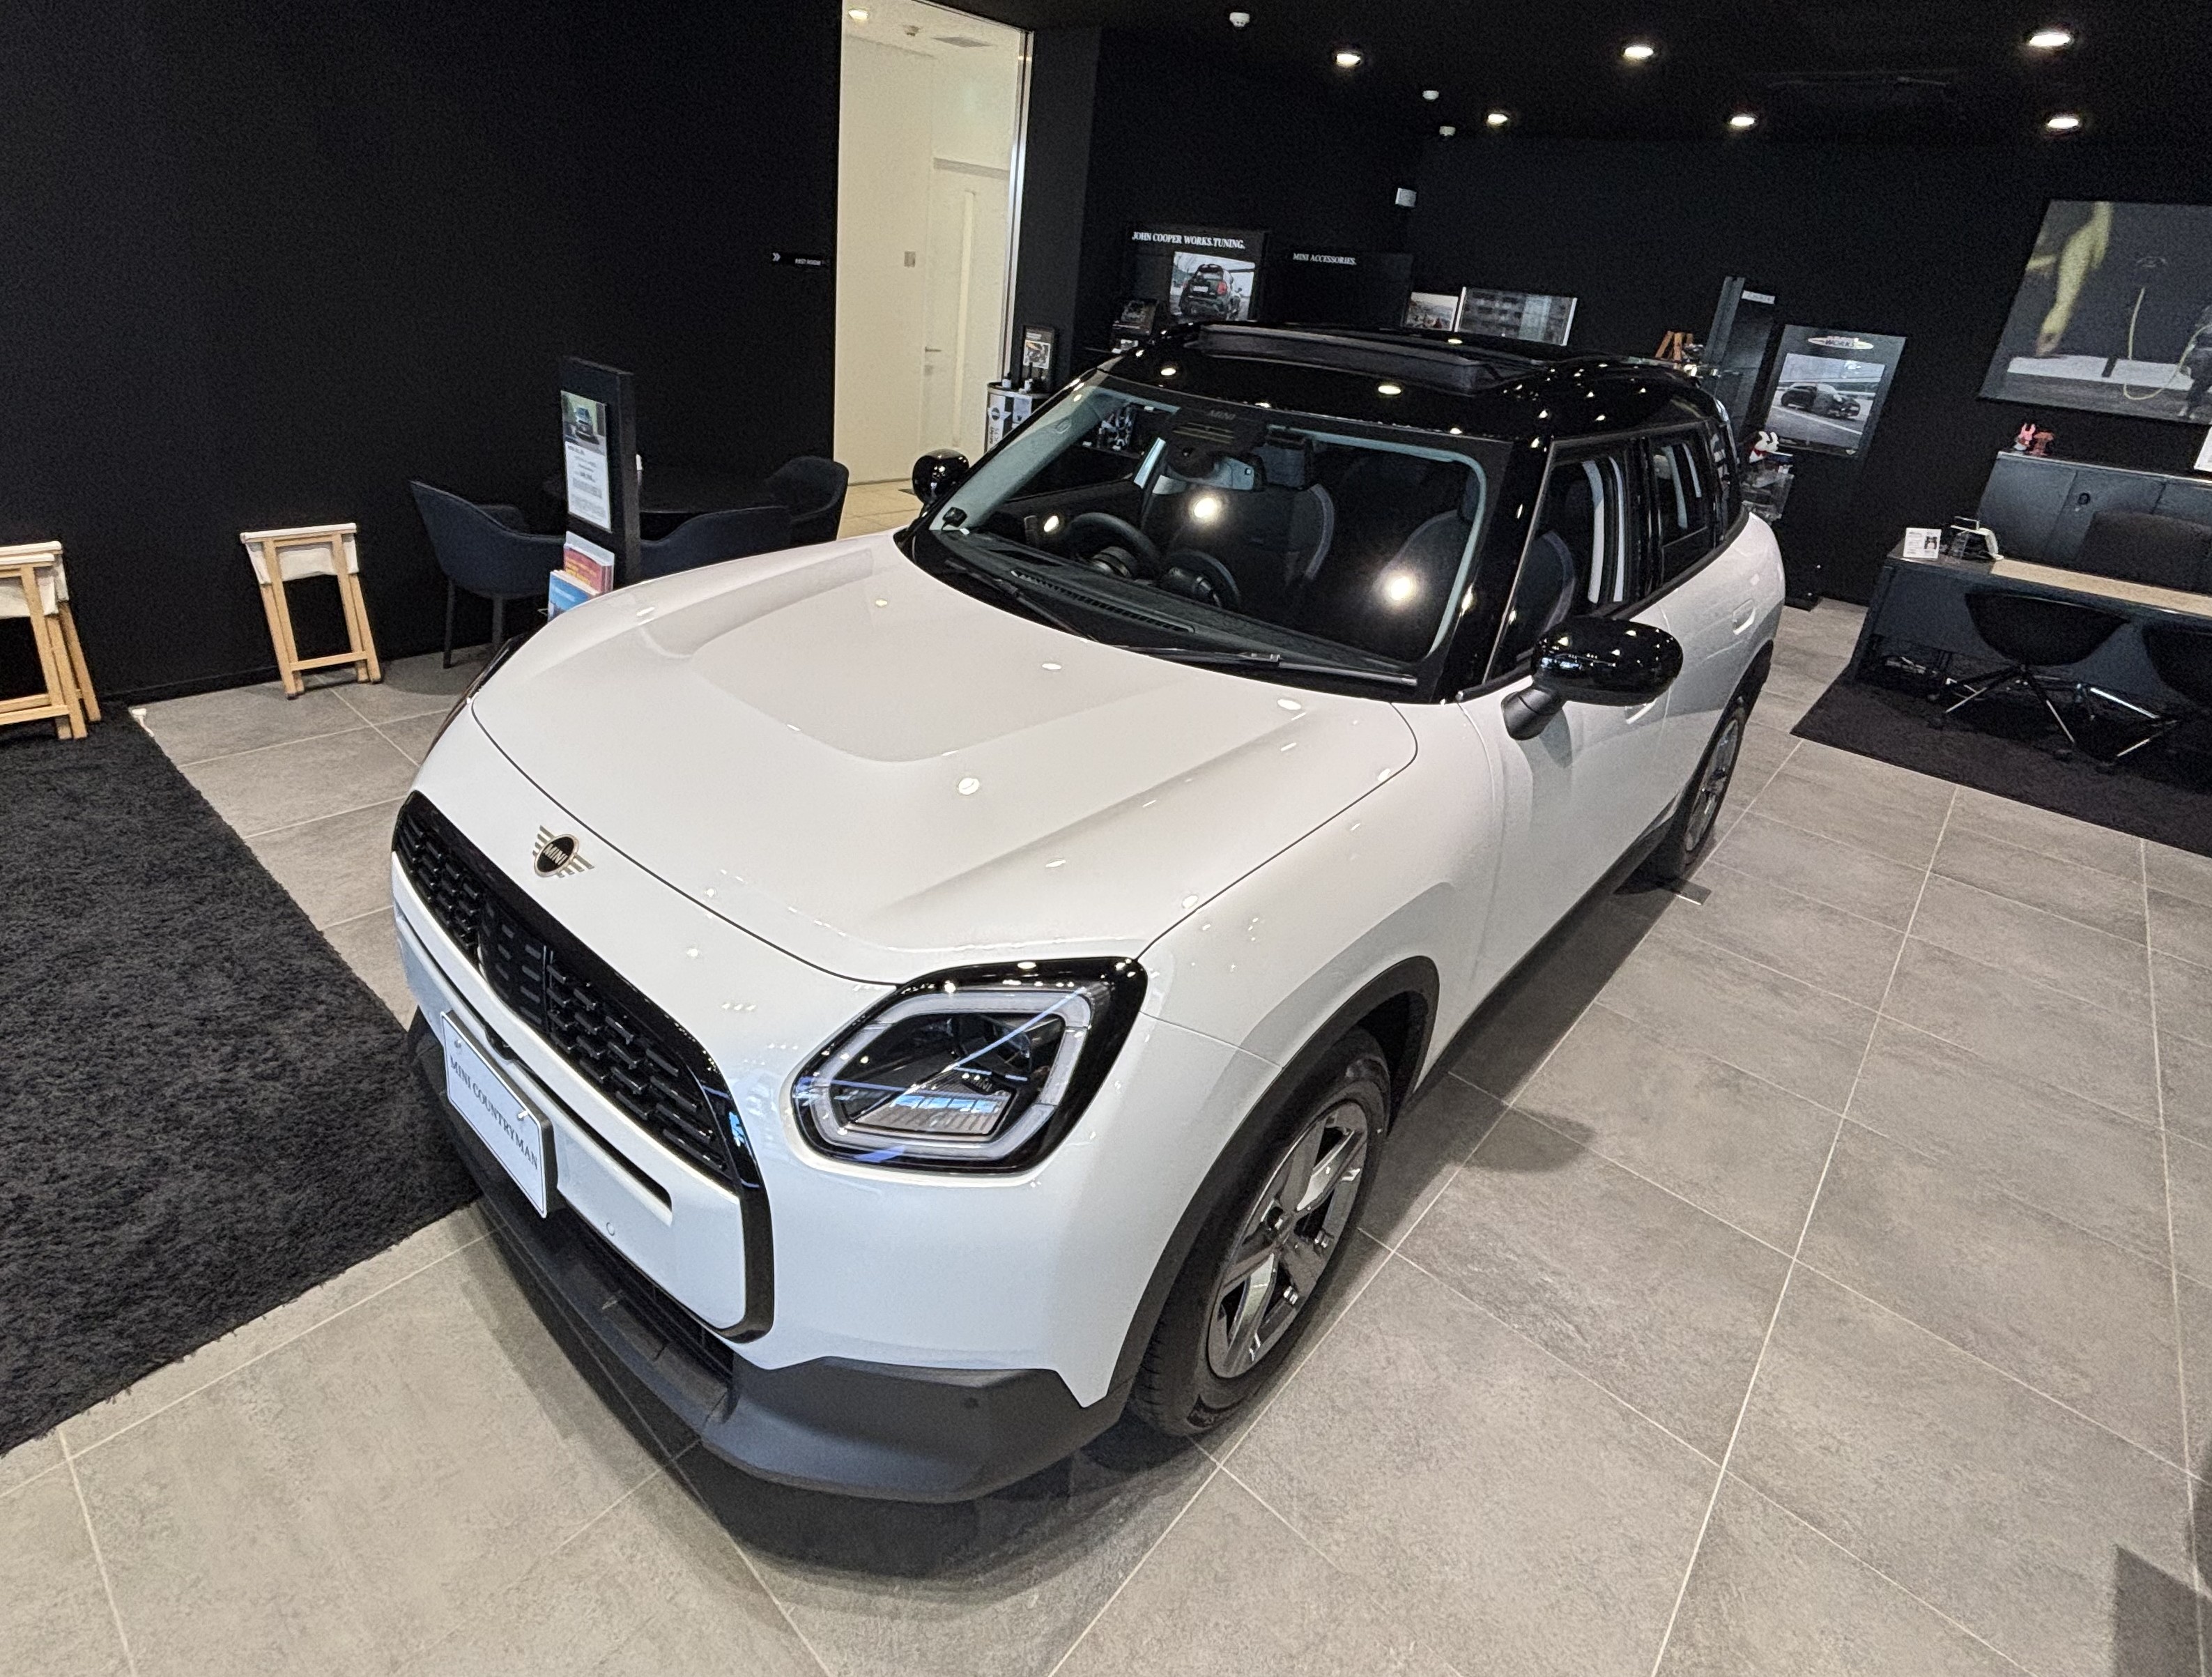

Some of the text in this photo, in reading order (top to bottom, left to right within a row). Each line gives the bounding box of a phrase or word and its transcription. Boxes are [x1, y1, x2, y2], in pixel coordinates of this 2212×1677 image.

[1132, 231, 1151, 241] JOHN
[1152, 233, 1182, 244] COOPER
[1293, 253, 1309, 261] MINI
[543, 843, 569, 865] MINI
[450, 1056, 538, 1170] MINI COUNTRYMAN
